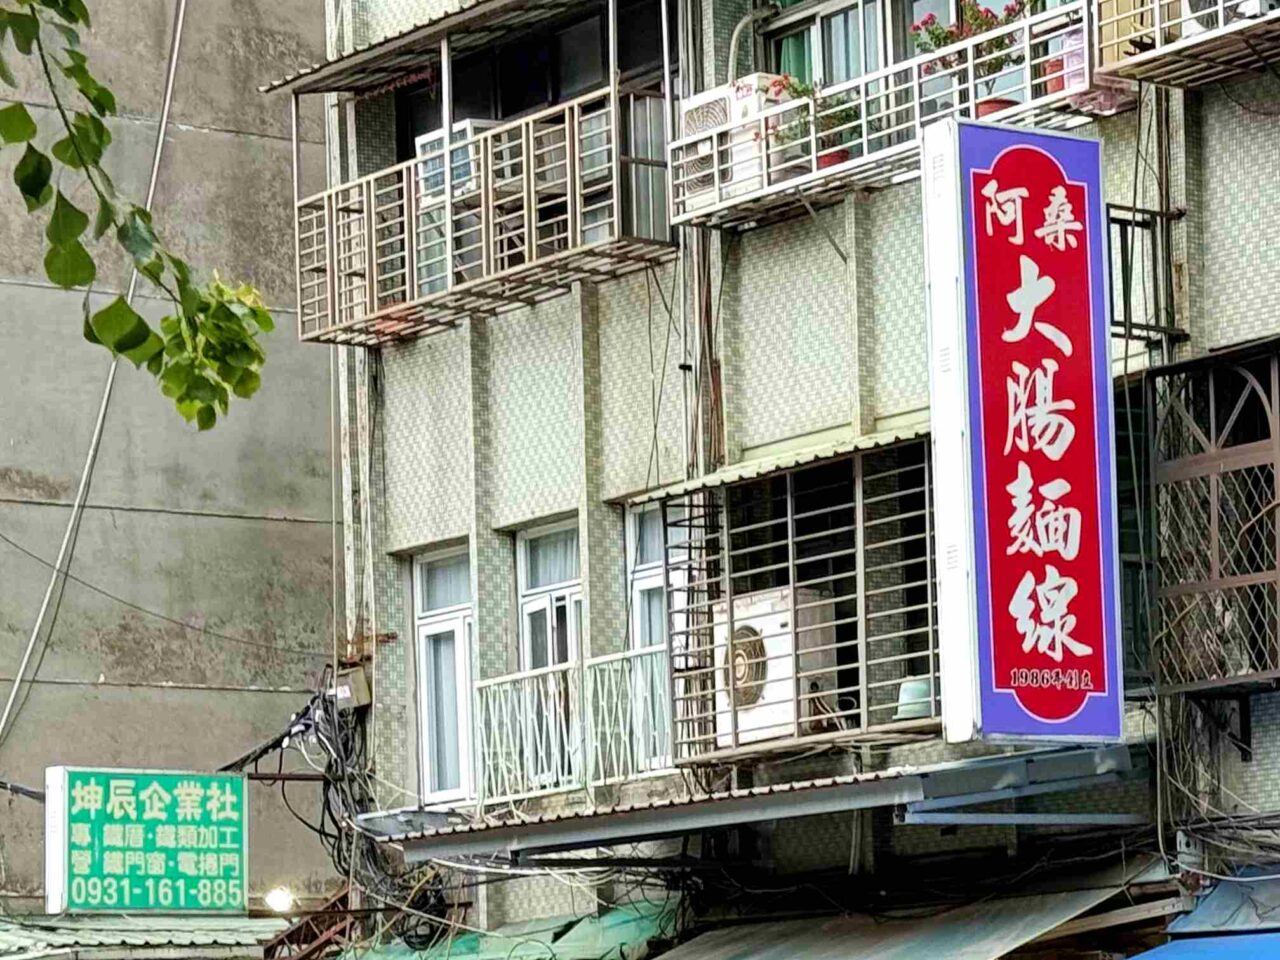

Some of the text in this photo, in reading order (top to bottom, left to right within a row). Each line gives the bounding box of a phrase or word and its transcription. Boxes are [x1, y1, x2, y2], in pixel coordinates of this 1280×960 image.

[981, 178, 1083, 251] 阿桑
[1001, 254, 1093, 663] 大腸麵線
[71, 777, 239, 822] 坤辰企業社
[71, 877, 241, 906] 0931-161-885
